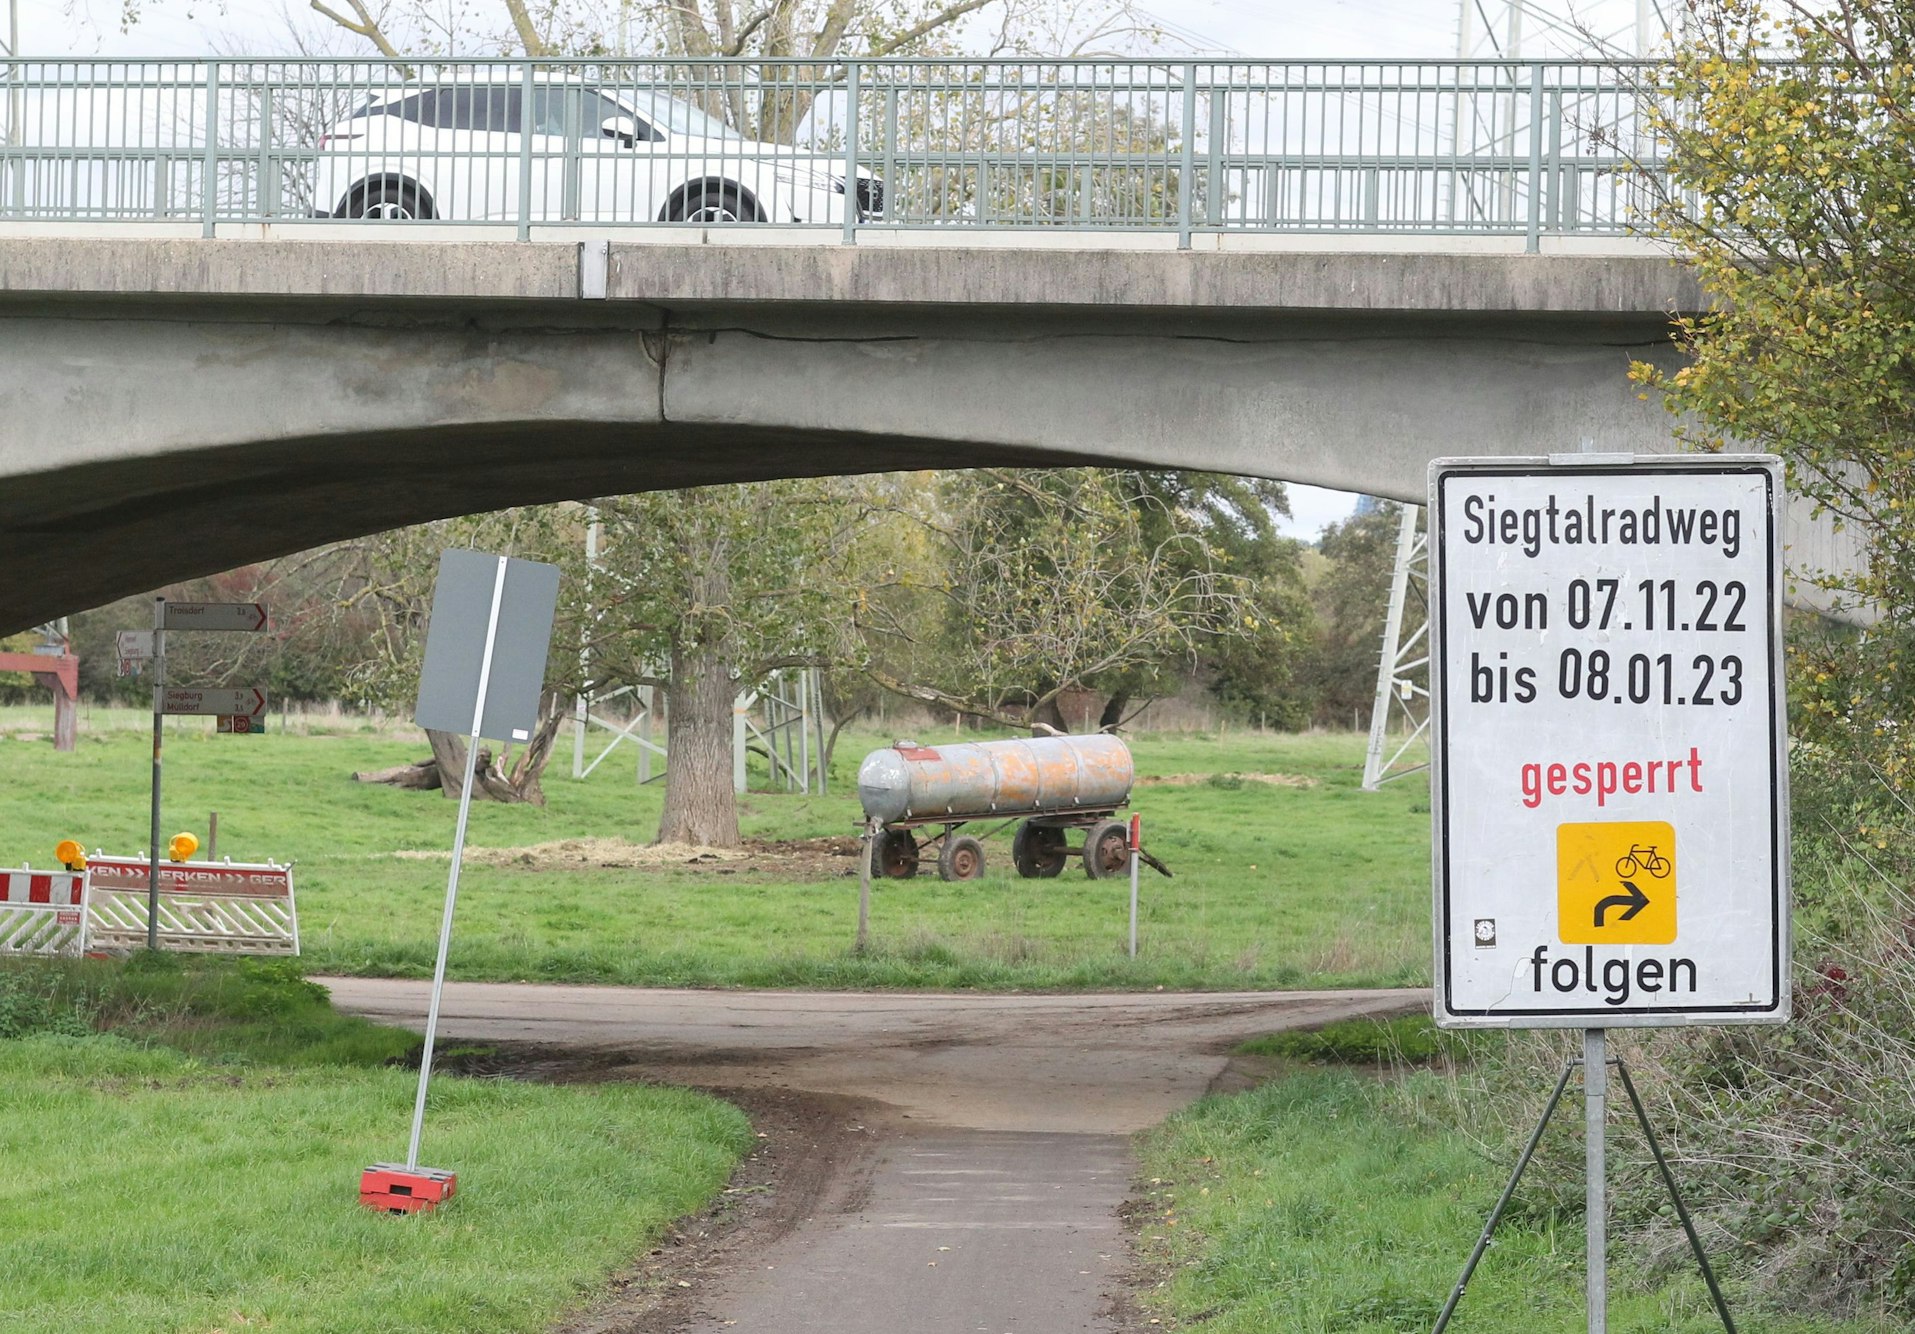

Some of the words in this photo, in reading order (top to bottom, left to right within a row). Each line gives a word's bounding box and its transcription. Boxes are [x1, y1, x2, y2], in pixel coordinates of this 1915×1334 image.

[1465, 496, 1739, 558] Siegtalradweg
[1467, 593, 1546, 629] von
[1569, 579, 1745, 631] 07.11.22
[167, 691, 203, 701] Siegburg
[1472, 653, 1536, 703] bis
[1559, 648, 1742, 705] 08.01.23
[1522, 747, 1703, 808] gesperrt
[1531, 946, 1696, 1005] folgen
